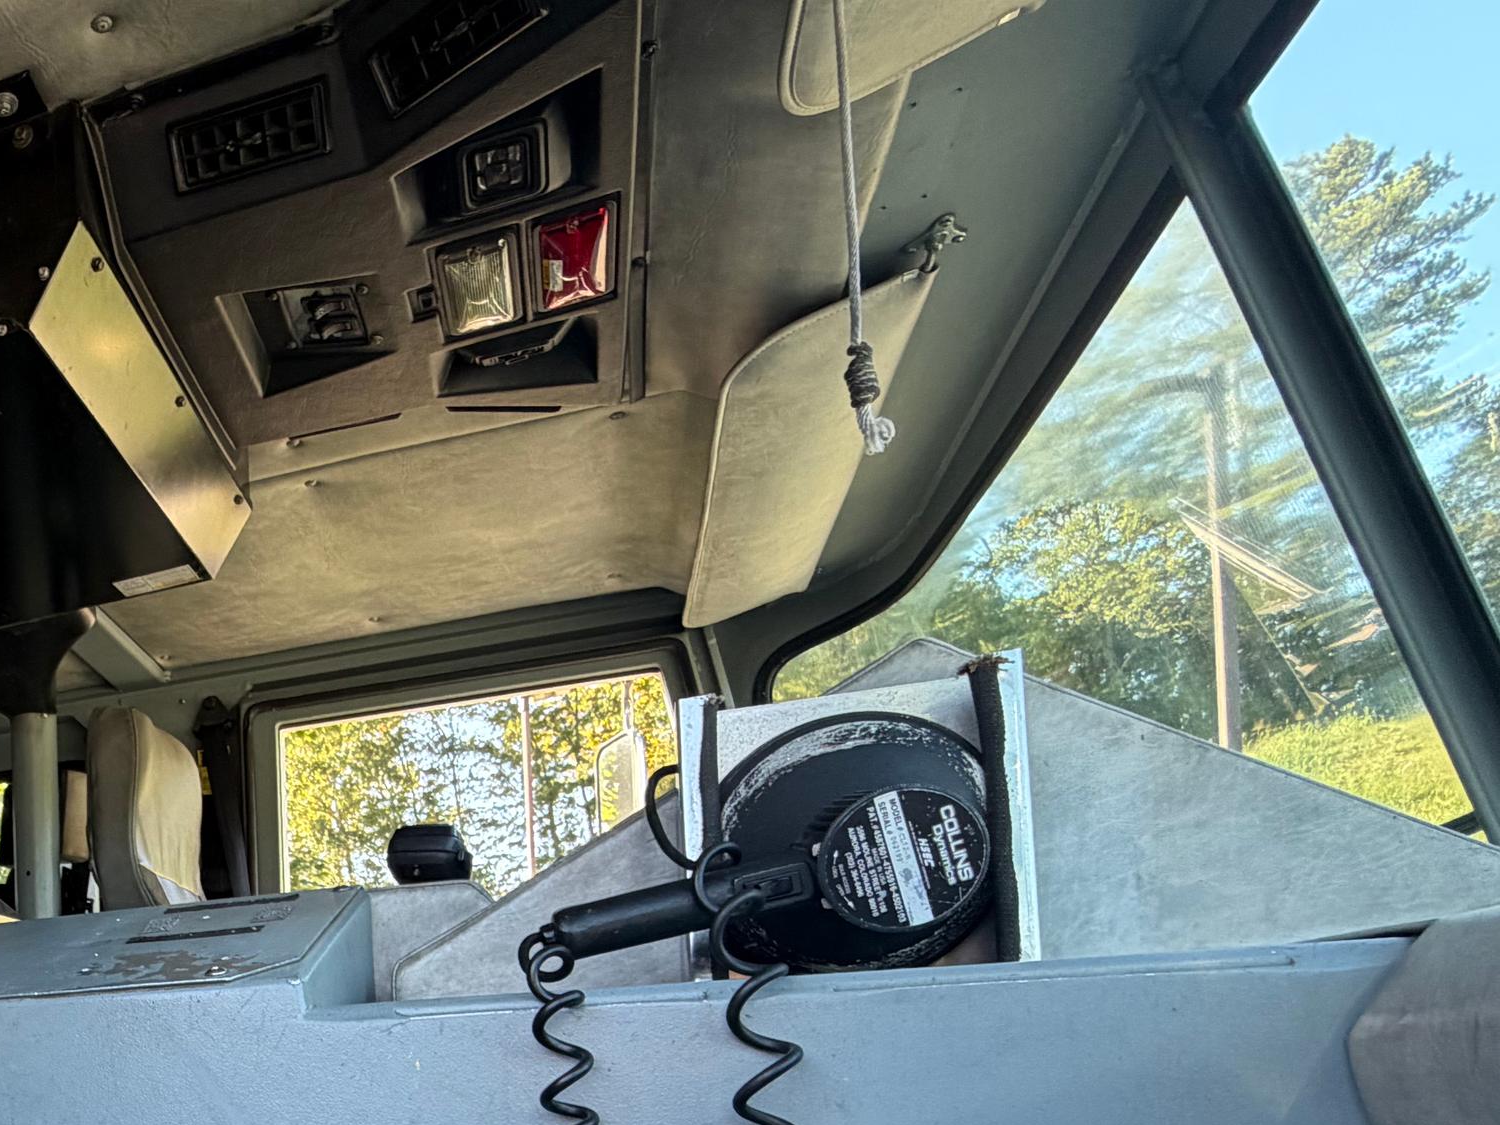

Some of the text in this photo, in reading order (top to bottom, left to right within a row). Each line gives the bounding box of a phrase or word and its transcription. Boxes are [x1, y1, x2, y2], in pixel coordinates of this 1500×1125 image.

[932, 822, 958, 886] Dynamics
[939, 803, 974, 883] COLLINS
[856, 857, 873, 897] COLORADO
